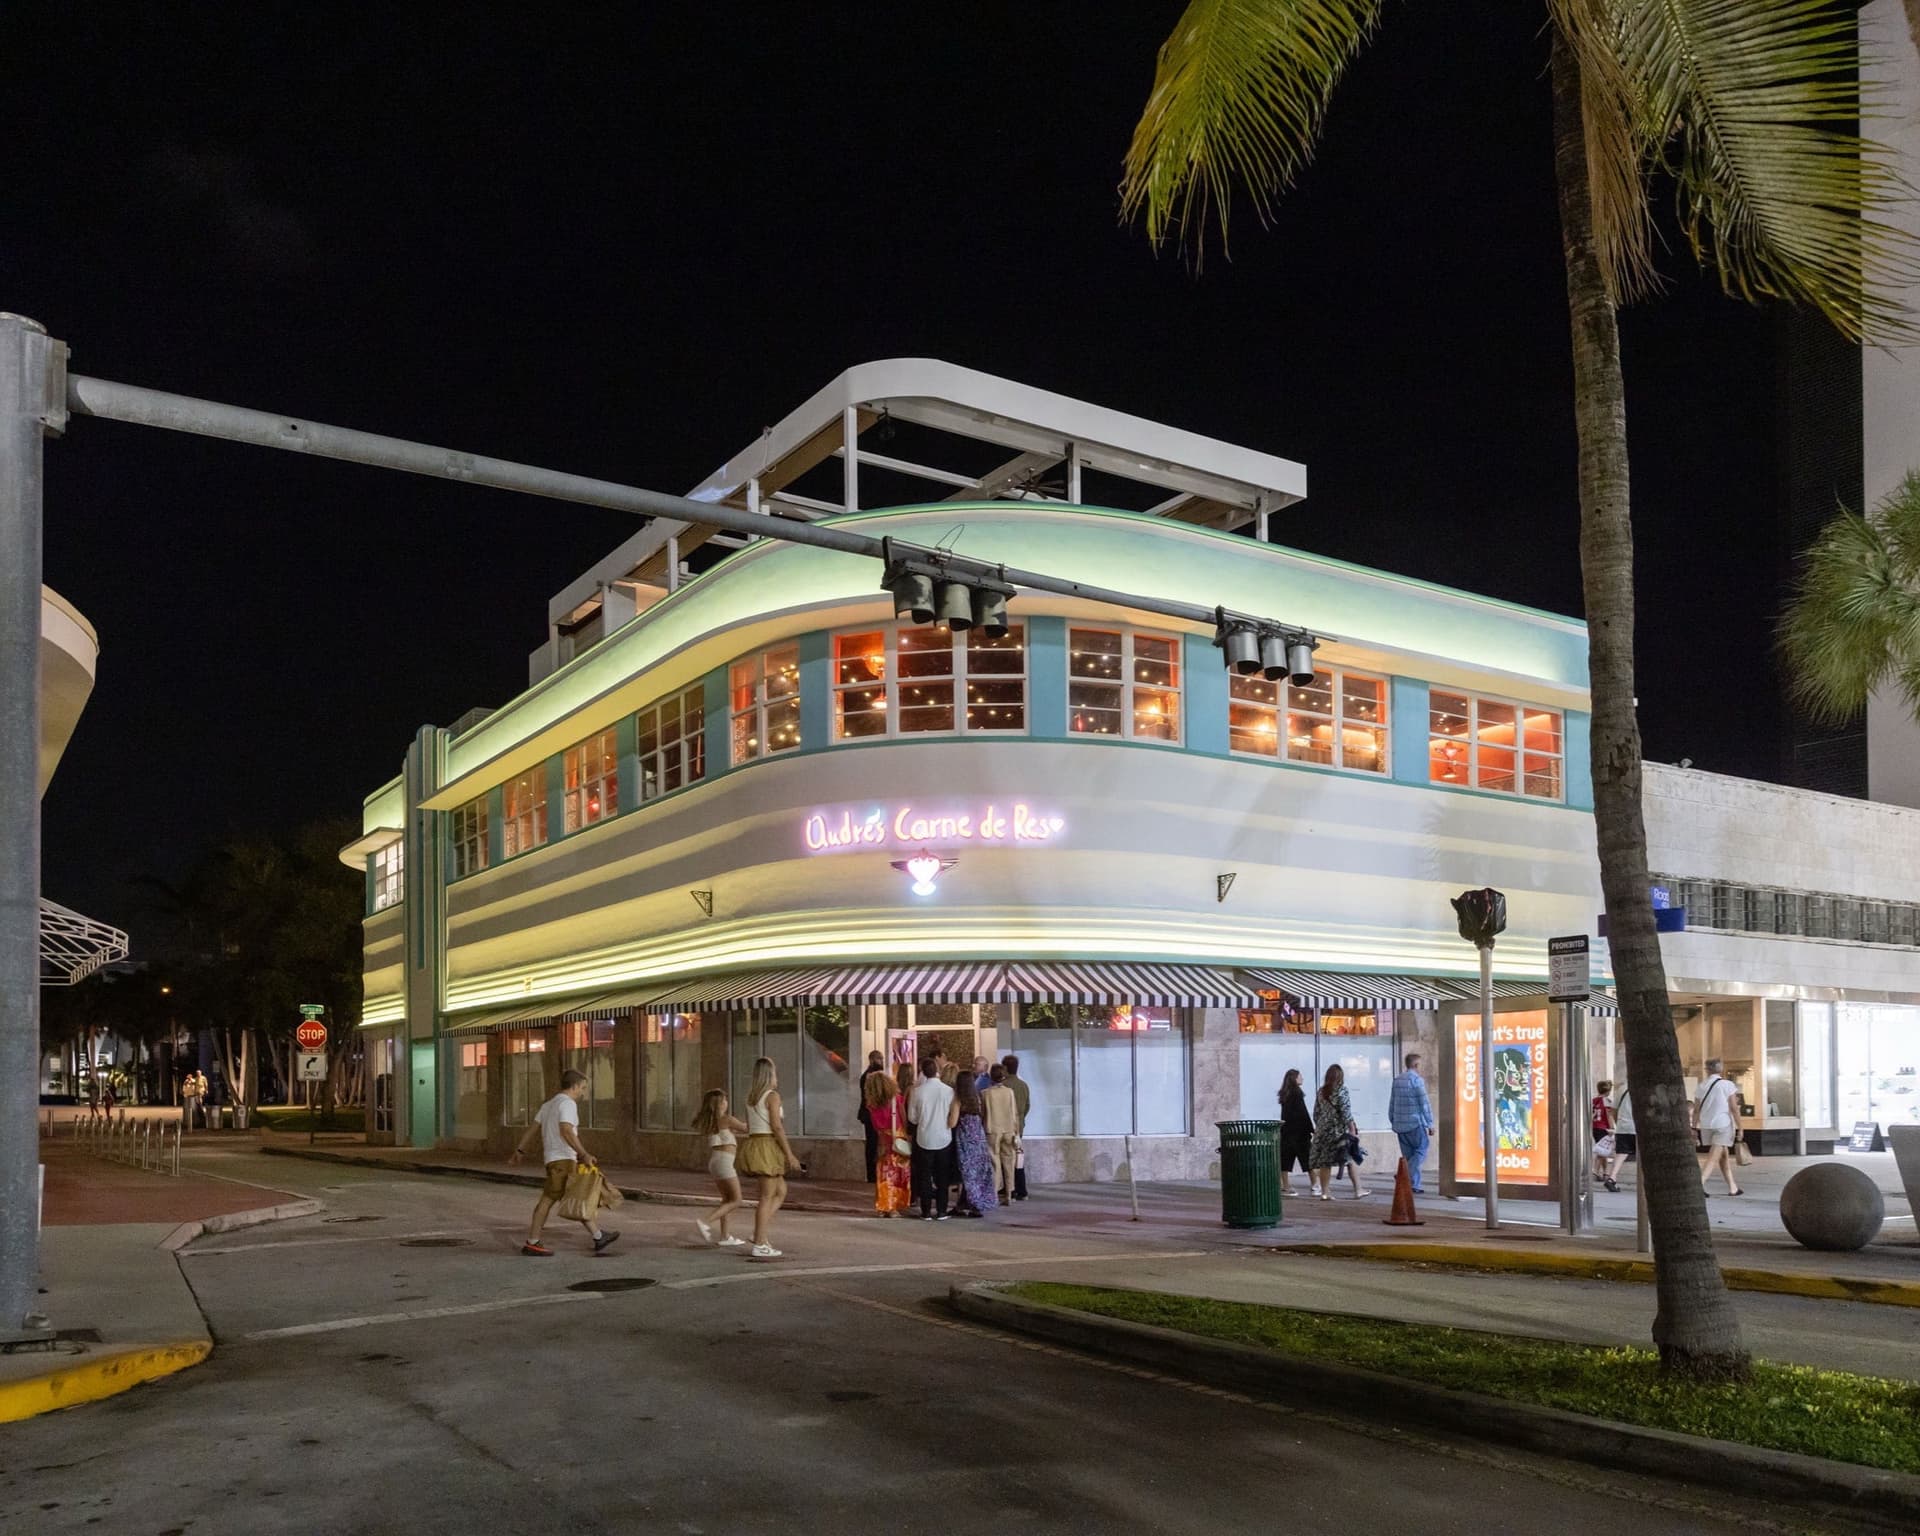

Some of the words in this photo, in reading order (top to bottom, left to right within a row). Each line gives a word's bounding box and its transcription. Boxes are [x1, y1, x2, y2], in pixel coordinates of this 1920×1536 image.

[894, 807, 973, 841] Carne
[980, 805, 1006, 838] de
[1014, 804, 1049, 840] Res
[1552, 939, 1585, 950] PROHIBITED
[300, 1029, 325, 1040] STOP
[1465, 1025, 1513, 1041] wt's
[1516, 1025, 1544, 1041] true
[1534, 1043, 1547, 1063] to
[1463, 1045, 1477, 1103] Create
[1533, 1067, 1545, 1105] you.
[1480, 1152, 1530, 1169] dobe
